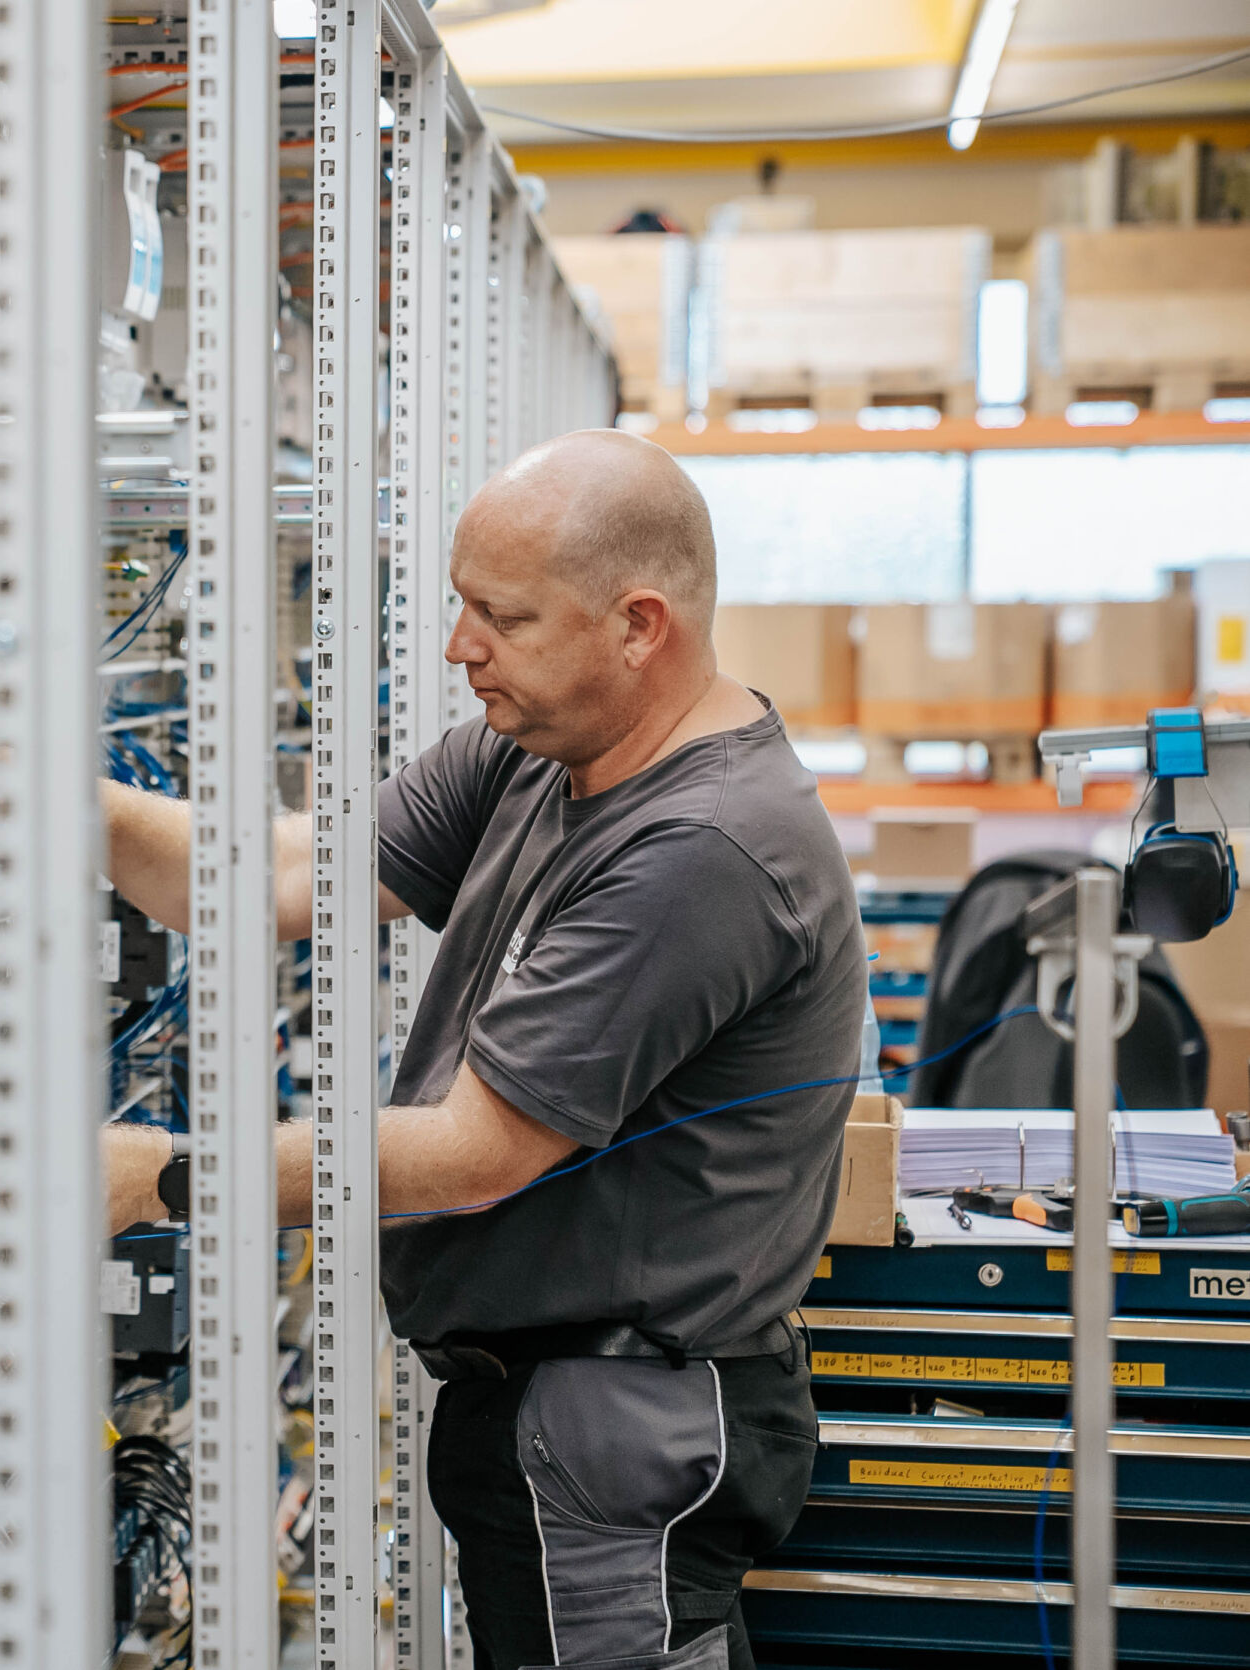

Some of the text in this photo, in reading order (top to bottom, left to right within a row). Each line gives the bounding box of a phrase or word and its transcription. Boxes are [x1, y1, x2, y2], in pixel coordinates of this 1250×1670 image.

[1193, 1275, 1250, 1296] me
[860, 1467, 910, 1480] Residual
[921, 1466, 964, 1481] Current
